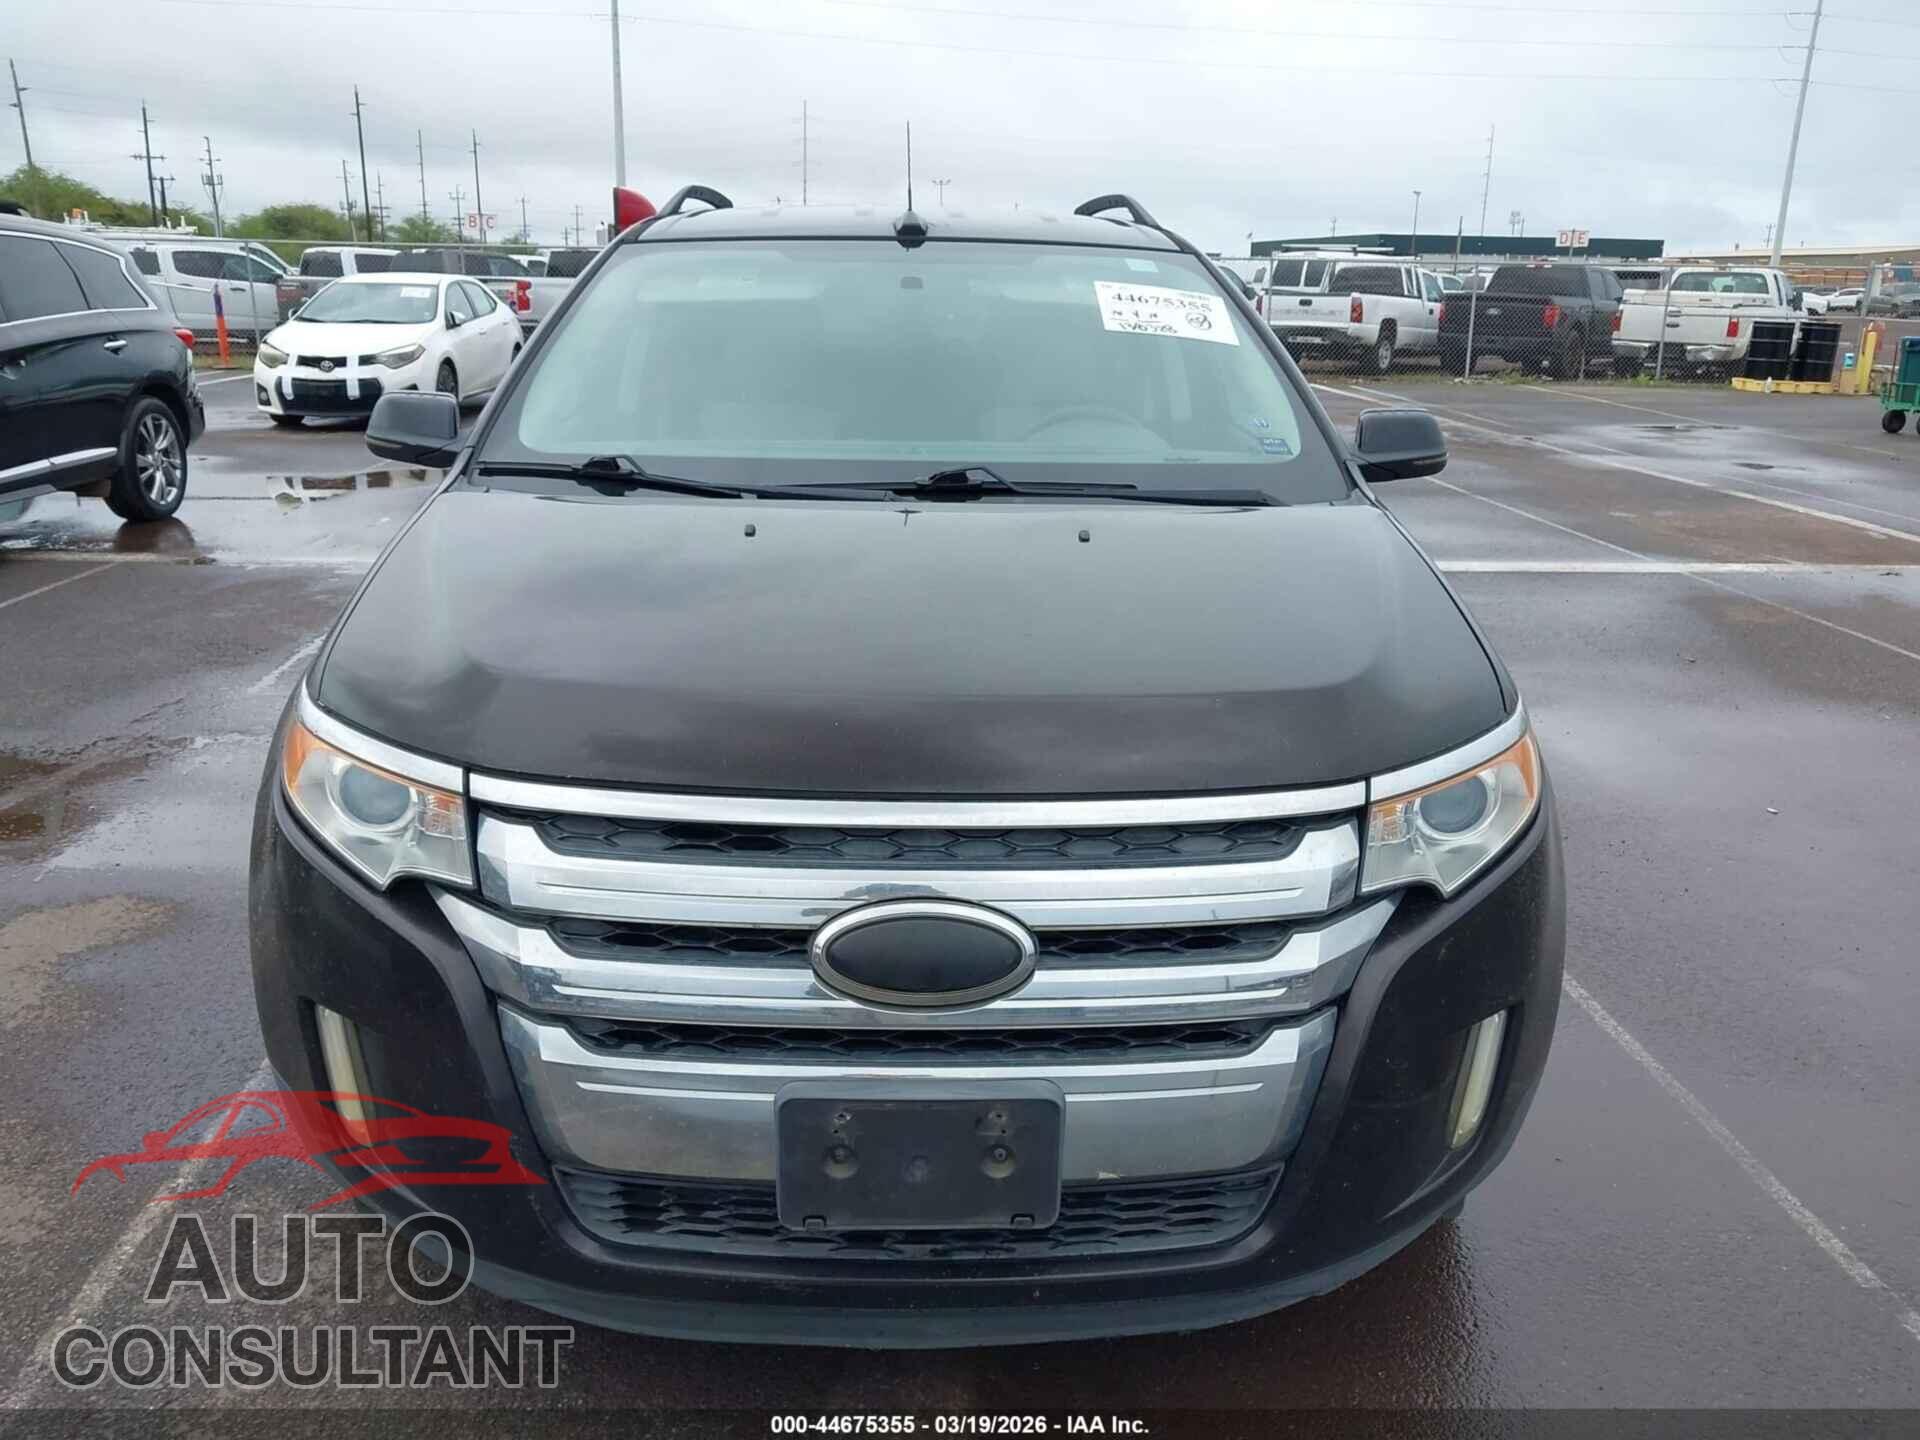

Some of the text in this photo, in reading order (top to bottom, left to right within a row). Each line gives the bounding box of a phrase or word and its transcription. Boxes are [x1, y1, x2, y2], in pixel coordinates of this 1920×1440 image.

[468, 215, 495, 229] B C
[1111, 292, 1213, 313] 44675355
